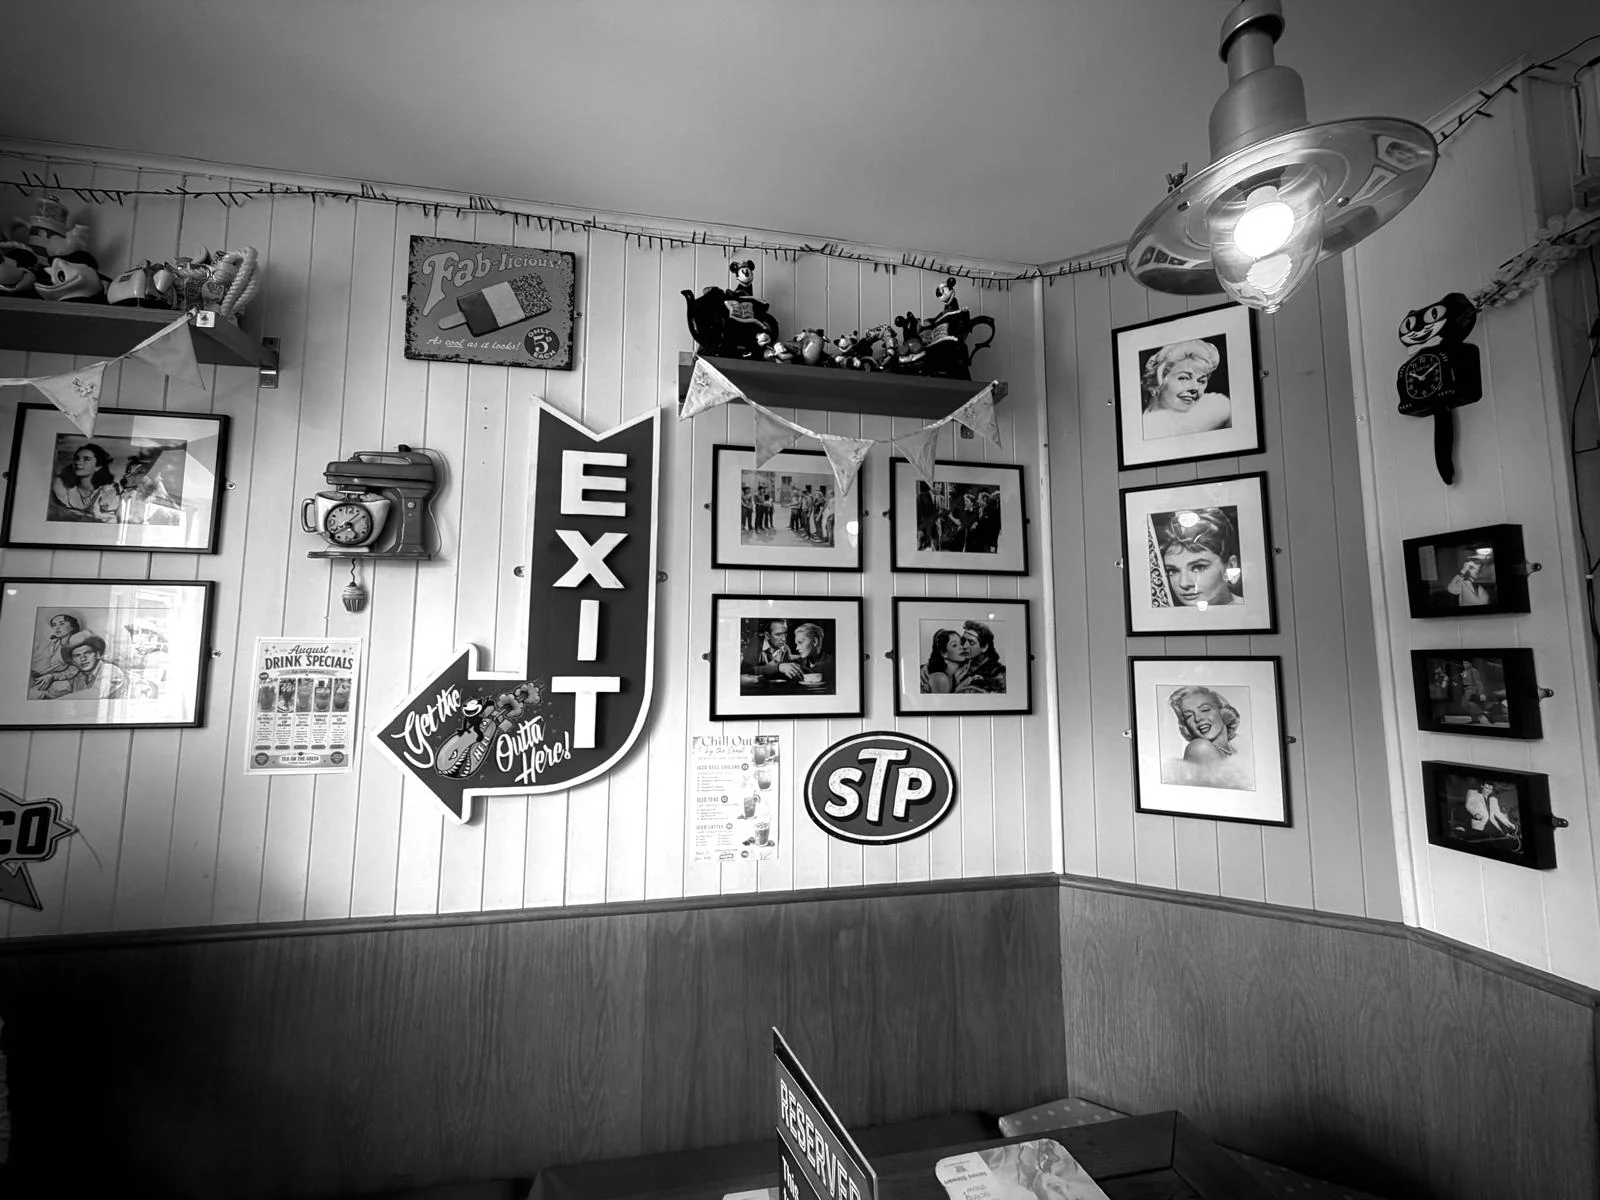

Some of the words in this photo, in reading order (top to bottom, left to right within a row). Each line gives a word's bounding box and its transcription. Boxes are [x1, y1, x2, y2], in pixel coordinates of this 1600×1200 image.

[422, 251, 561, 316] Fab-licious!
[528, 328, 551, 338] ONLY
[533, 350, 556, 359] EACH
[551, 449, 629, 749] EXIT
[265, 655, 302, 670] DRINK
[306, 654, 353, 670] SPECIALS
[288, 644, 329, 656] August
[390, 710, 439, 769] Get
[435, 684, 463, 723] the
[496, 715, 546, 772] Outta
[701, 735, 729, 747] Chill
[731, 735, 752, 747] Out
[473, 735, 491, 761] HELL
[514, 731, 571, 785] Here!
[824, 748, 933, 823] STP
